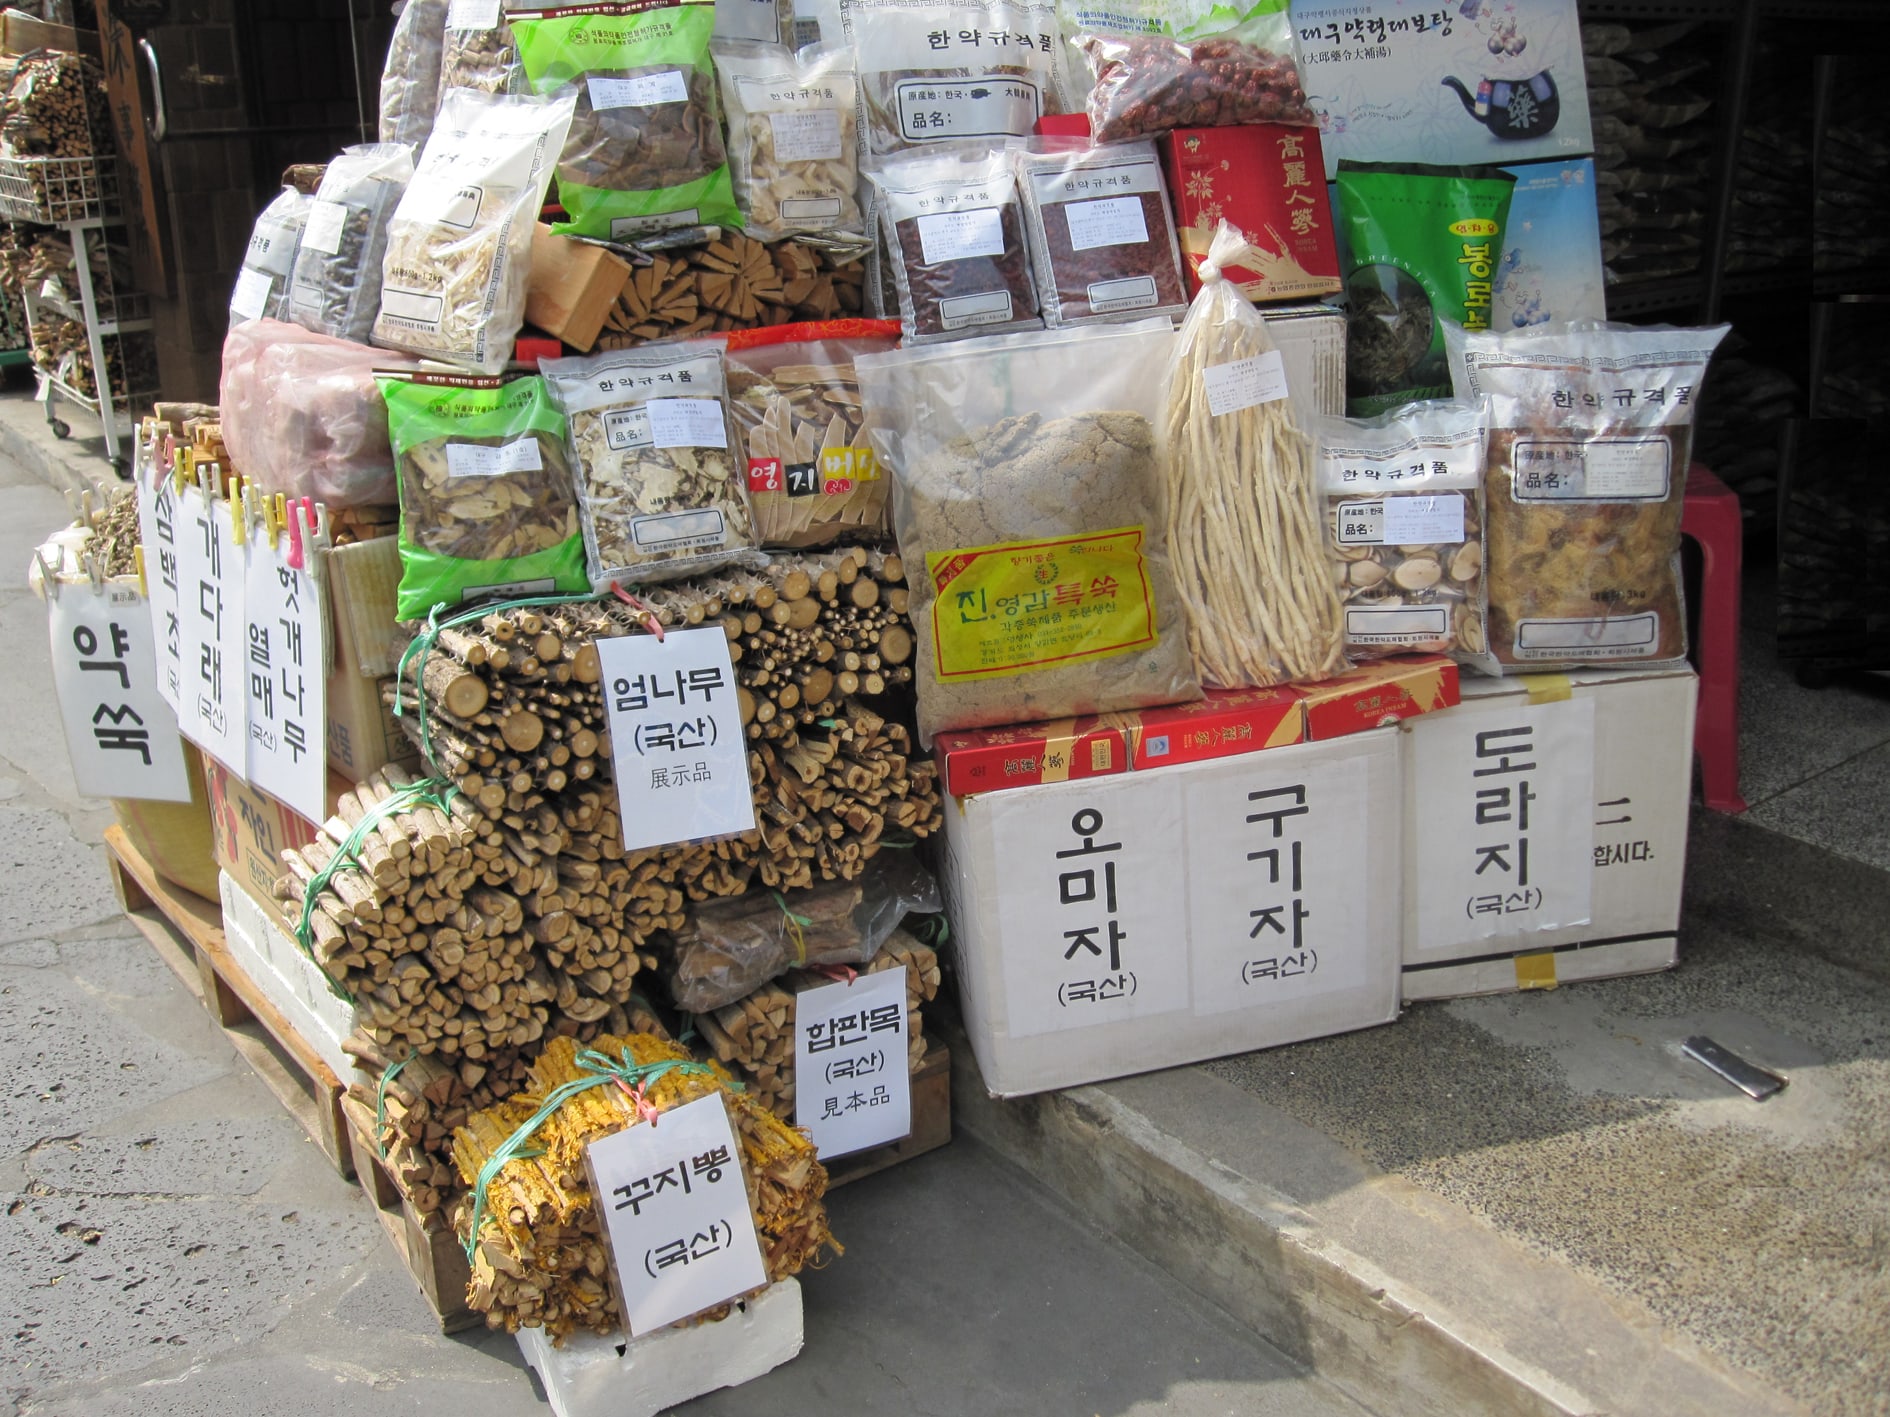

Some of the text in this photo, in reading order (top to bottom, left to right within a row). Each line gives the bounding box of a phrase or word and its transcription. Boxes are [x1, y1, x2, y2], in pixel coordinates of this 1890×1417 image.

[926, 29, 1054, 54] 한약규격품
[1299, 10, 1453, 44] 대구약령대보탕
[912, 111, 952, 130] 品名:
[918, 191, 991, 208] 한약규격품
[1064, 174, 1133, 193] 한약규격품
[599, 369, 694, 393] 한약규격품
[1551, 383, 1693, 410] 한약규격품
[615, 428, 643, 443] 品名:
[1341, 460, 1448, 482] 한약규격품
[1526, 471, 1569, 489] 品名:
[1345, 523, 1373, 536] 品名:
[196, 518, 224, 706] 개다래
[1068, 601, 1117, 620] 주문생산
[248, 622, 274, 721] 열매
[276, 565, 308, 765] 헛개나무
[613, 666, 725, 712] 엄나무
[196, 694, 228, 740] (국산)
[1363, 702, 1407, 719] KOREA INSAM
[248, 722, 277, 753] (국산)
[633, 714, 718, 757] (국산)
[650, 761, 712, 791] 展示品
[1473, 725, 1537, 886] 도라지
[1245, 783, 1309, 949] 구기자
[1055, 807, 1126, 971] 오미자
[1466, 886, 1543, 920] (국산)
[1241, 948, 1318, 986] (국산)
[1057, 971, 1137, 1007] (국산)
[805, 1003, 902, 1055] 합판목
[825, 1049, 885, 1085] (국산)
[820, 1085, 890, 1121] 見本品
[613, 1144, 732, 1217] 꾸지뽕
[644, 1218, 733, 1279] (국산)
